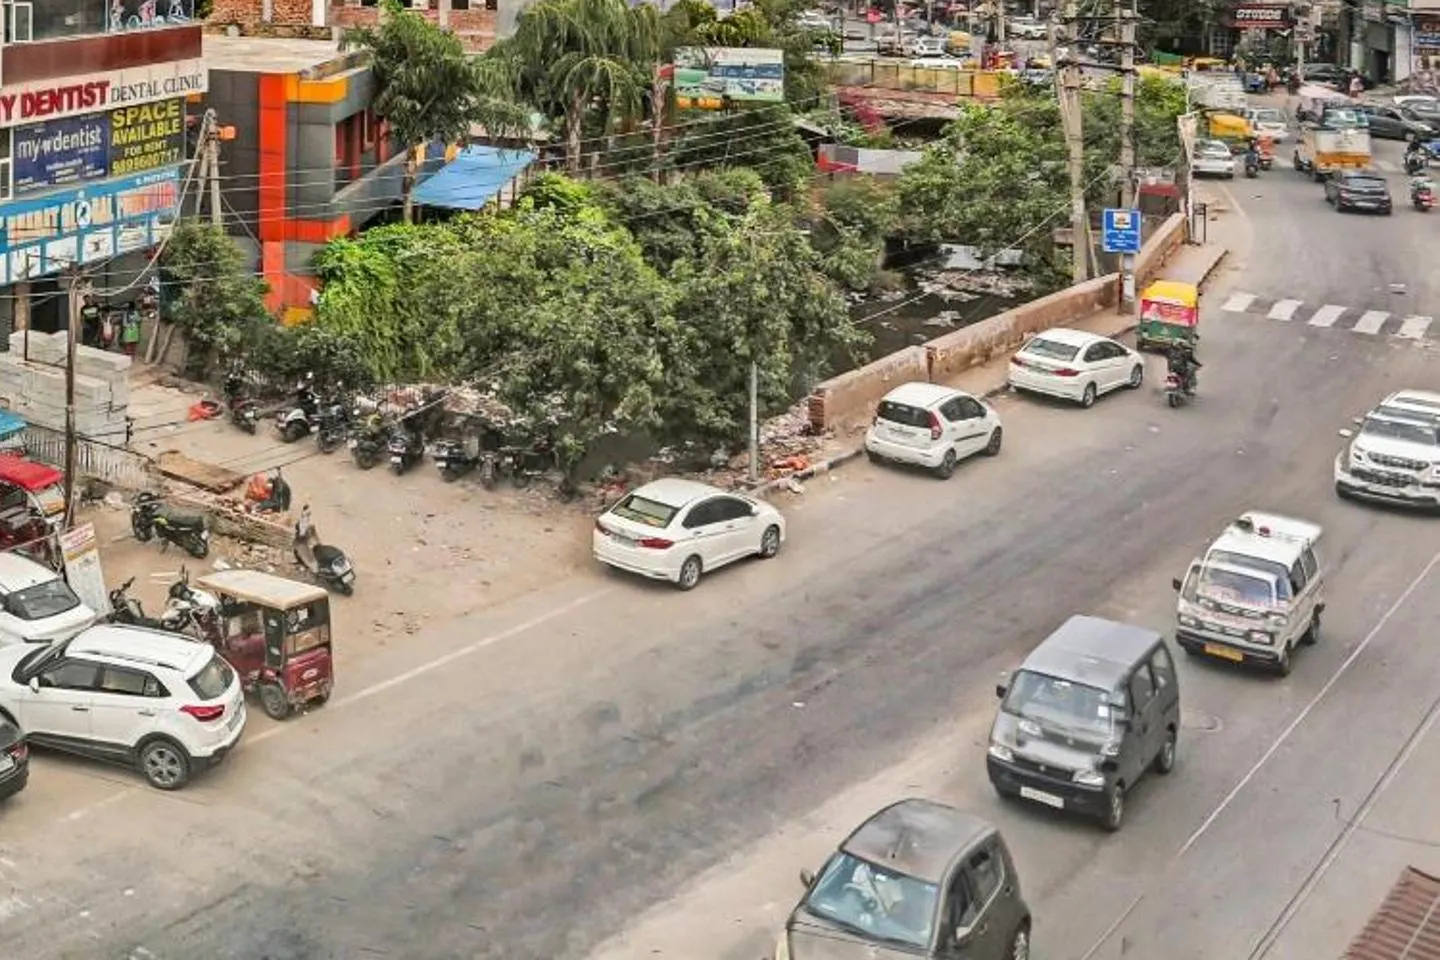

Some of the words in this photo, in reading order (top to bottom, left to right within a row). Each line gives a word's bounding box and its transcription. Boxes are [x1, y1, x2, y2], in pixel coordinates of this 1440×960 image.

[20, 81, 110, 119] DENTIST
[111, 83, 160, 103] DENTAL
[163, 74, 203, 92] CLINIC
[112, 100, 181, 129] SPACE
[111, 118, 181, 146] AVAILABLE
